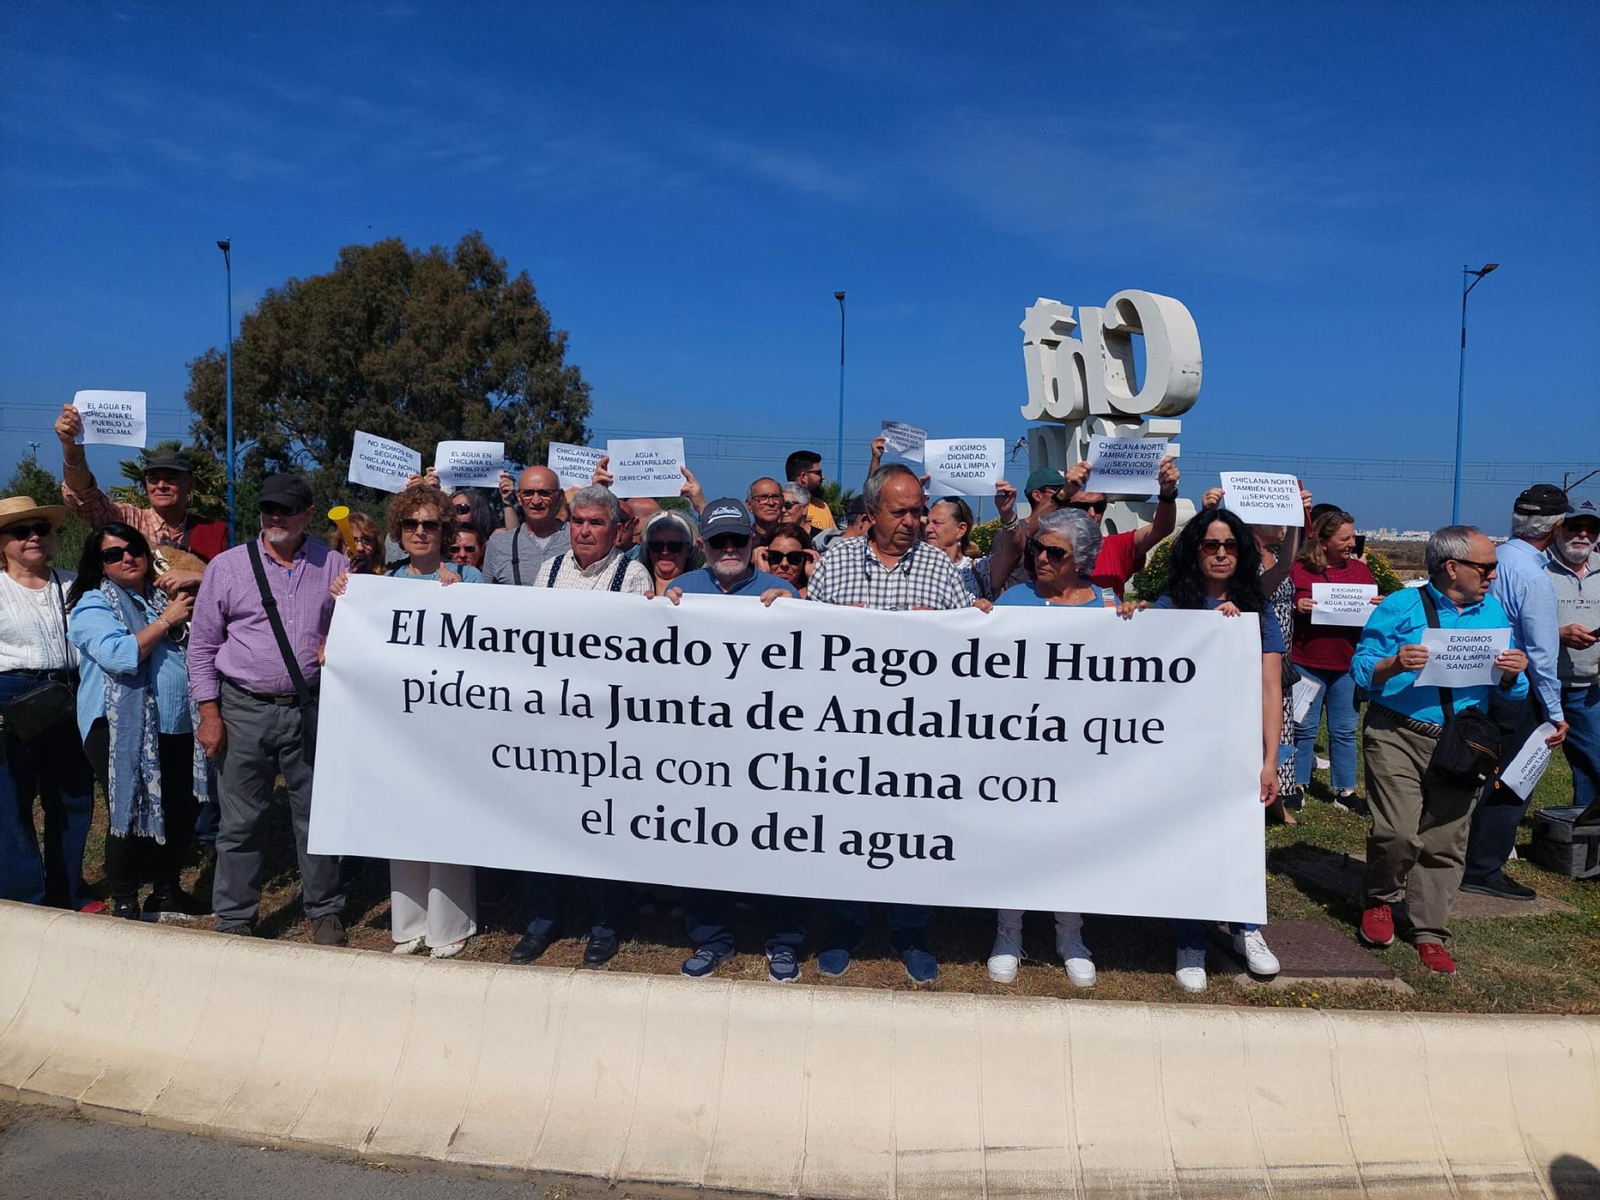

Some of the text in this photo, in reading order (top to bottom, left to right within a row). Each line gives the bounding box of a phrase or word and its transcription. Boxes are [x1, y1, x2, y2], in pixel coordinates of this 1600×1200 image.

[88, 402, 96, 410] EL
[98, 403, 120, 411] AGUA
[85, 411, 124, 419] CHICLANA
[1099, 442, 1139, 450] CHICLANA
[380, 443, 405, 455] SOMOS
[405, 452, 414, 460] DE
[556, 448, 590, 457] CHICLANA
[1099, 451, 1134, 459] TAMBIÉN
[374, 450, 409, 463] SEGUNDA
[359, 454, 420, 474] CHICLANA NORTE
[449, 458, 484, 466] CHICLANA
[619, 459, 677, 467] ALCANTARILLADO
[366, 464, 410, 478] MERECE MÁ
[1099, 468, 1134, 476] BÁSICOS
[1271, 478, 1297, 486] NORTE
[1450, 635, 1493, 643] EXIGIMOS
[387, 610, 1196, 687] El Marquesado y el Pago del Humo
[402, 671, 1165, 756] piden a la Junta de Andalucía que
[1520, 746, 1543, 774] SANIDAD
[491, 741, 1059, 803] cumpla con Chiclana con
[581, 799, 956, 870] el ciclo del agua
